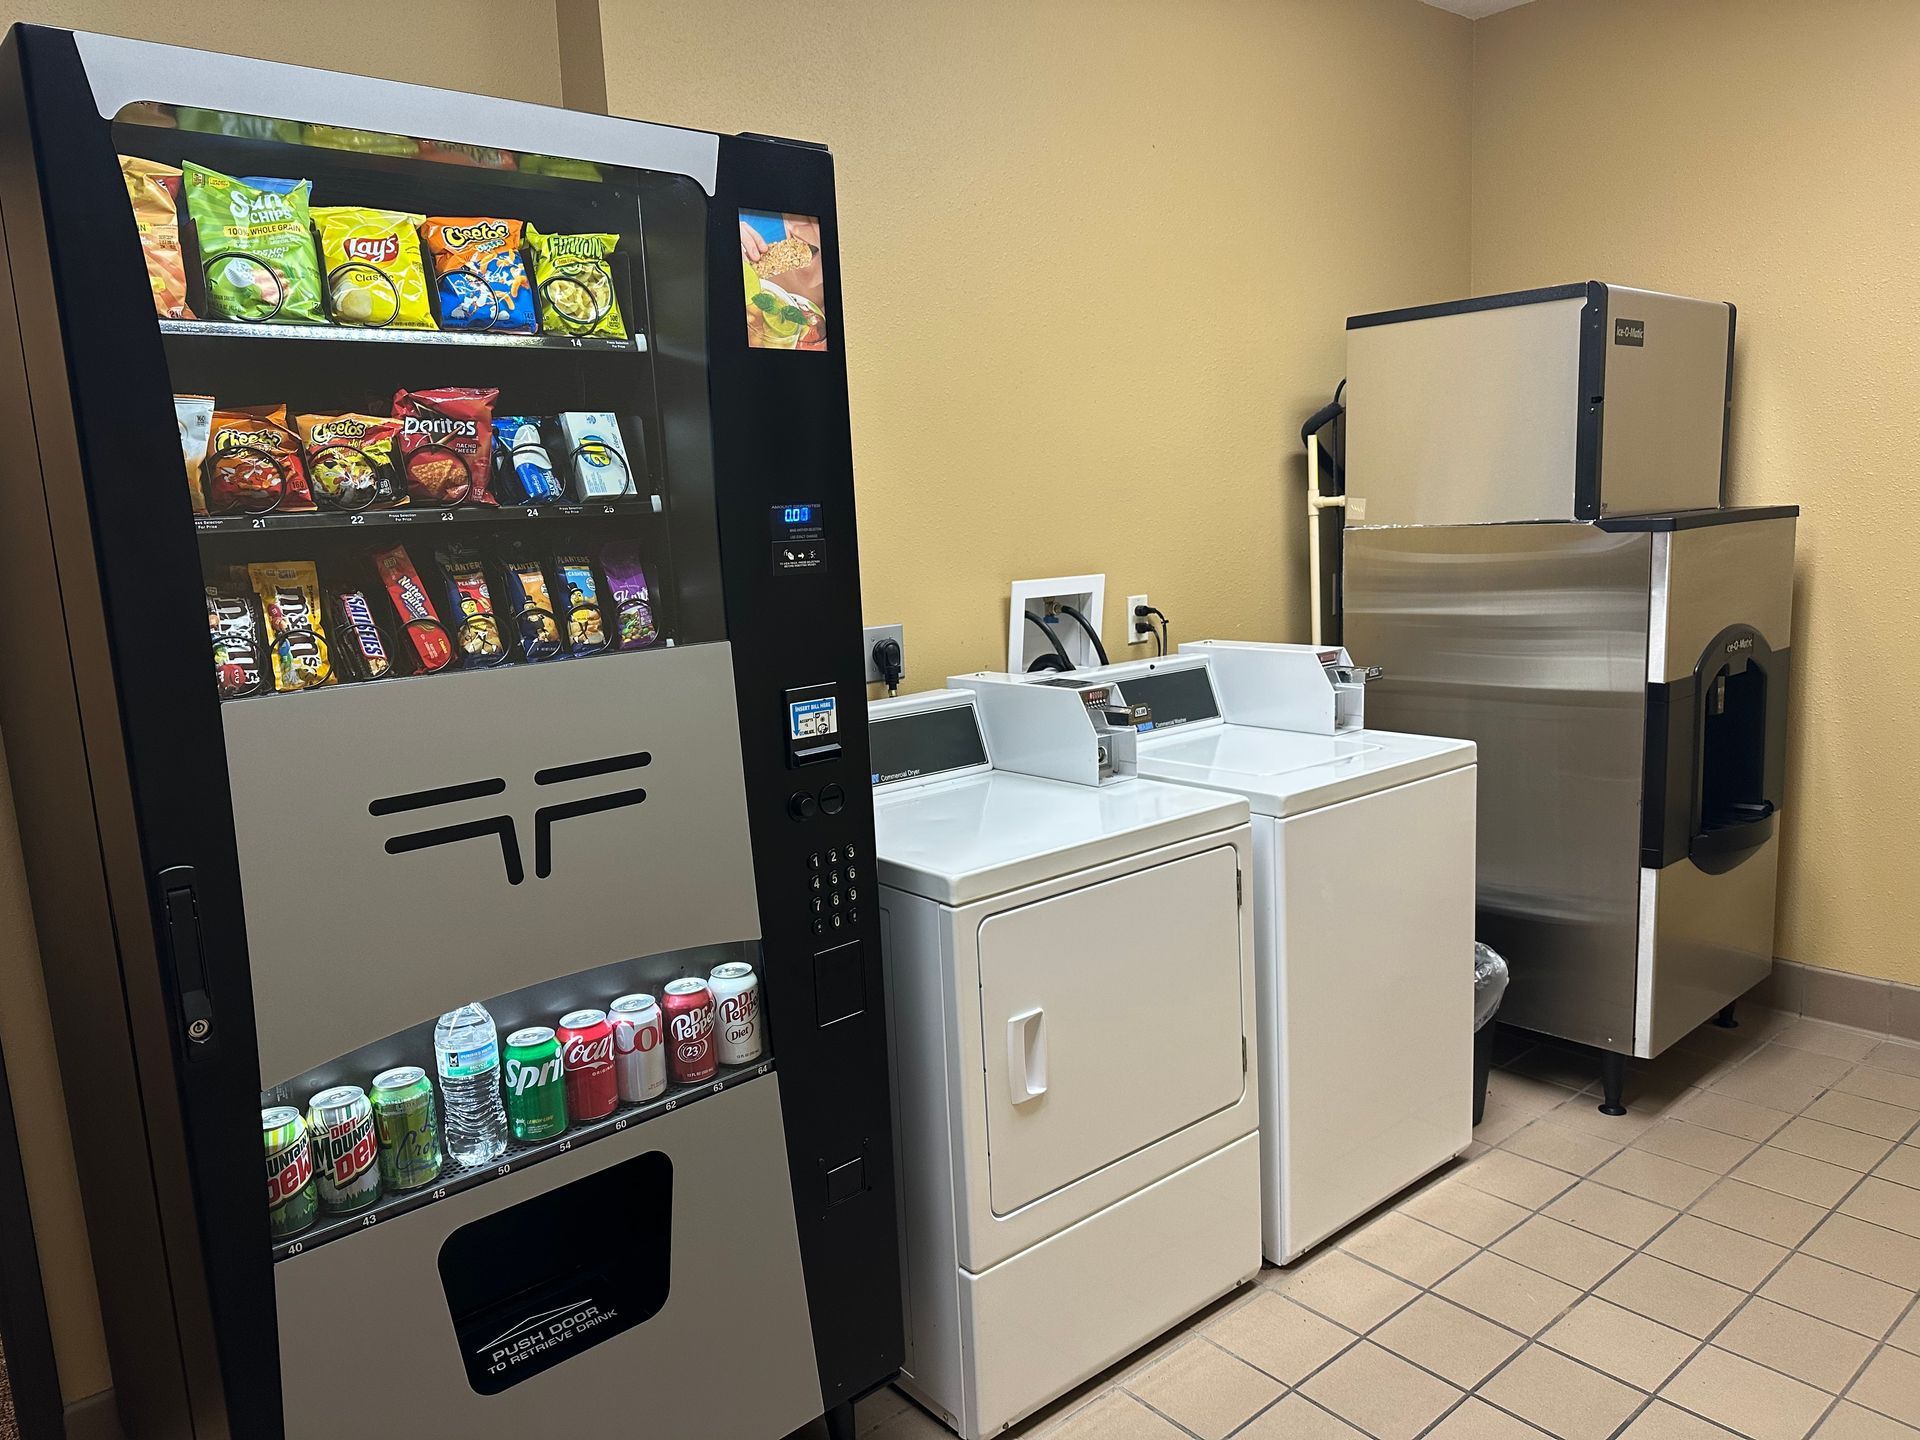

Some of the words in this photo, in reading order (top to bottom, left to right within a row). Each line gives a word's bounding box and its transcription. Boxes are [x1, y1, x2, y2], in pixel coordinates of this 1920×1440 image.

[229, 190, 283, 218] Sun
[250, 209, 292, 224] CHIPS
[250, 226, 277, 236] WHOLE
[277, 223, 301, 233] GRAIN
[444, 222, 509, 247] Cheetos
[349, 237, 397, 263] Lay's
[571, 339, 582, 347] 14
[312, 420, 363, 443] Cheetos
[404, 416, 477, 436] Doritos
[527, 509, 539, 517] 24
[603, 505, 615, 513] 25
[785, 507, 808, 522] 0.00
[350, 515, 365, 524] 22
[440, 512, 454, 521] 23
[252, 519, 266, 528] 21
[398, 575, 426, 602] Nutter
[400, 590, 429, 618] Butter
[880, 771, 907, 782] Commercial
[907, 769, 921, 777] Dryer
[813, 856, 819, 867] 1
[831, 851, 837, 862] 2
[848, 846, 855, 858] 3
[813, 878, 820, 889] 4
[832, 873, 838, 884] 5
[849, 867, 856, 879] 6
[815, 900, 821, 911] 7
[833, 894, 840, 905] 8
[850, 889, 857, 900] 9
[834, 915, 840, 927] 0
[737, 989, 754, 1009] Dr
[689, 1005, 708, 1026] Dr
[671, 1011, 714, 1041] Pepper
[731, 1026, 749, 1041] Diet
[686, 1046, 699, 1057] 23
[757, 1064, 768, 1075] 64
[713, 1082, 724, 1093] 63
[665, 1101, 677, 1111] 62
[615, 1119, 627, 1131] 60
[559, 1141, 572, 1152] 54
[498, 1164, 511, 1175] 50
[432, 1189, 446, 1200] 45
[362, 1214, 377, 1226] 43
[288, 1242, 303, 1255] 40
[492, 1331, 545, 1362] PUSH
[549, 1306, 600, 1336] DOOR
[488, 1361, 507, 1375] TO
[510, 1329, 574, 1365] RETRIEVE
[576, 1308, 618, 1333] DRINK
